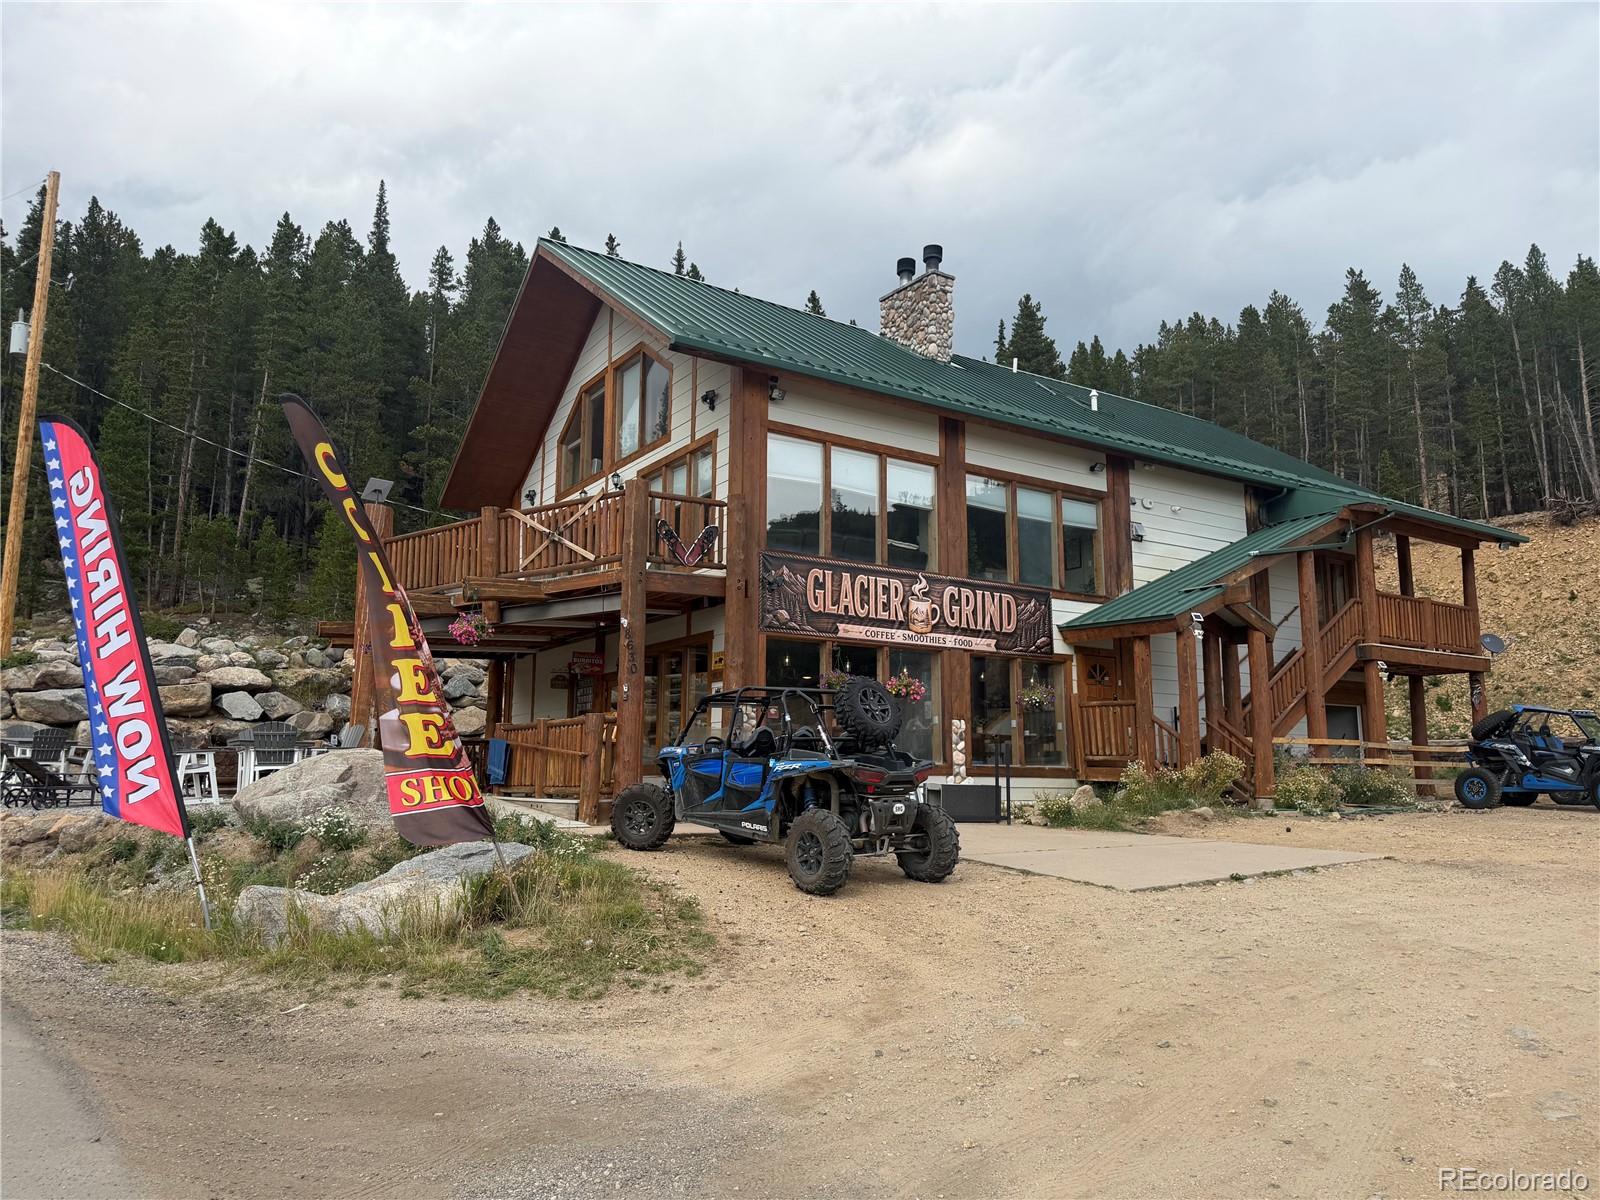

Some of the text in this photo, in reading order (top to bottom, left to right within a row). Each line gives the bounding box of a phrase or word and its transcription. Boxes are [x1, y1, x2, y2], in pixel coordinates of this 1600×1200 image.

[806, 568, 1018, 633] GLACIER GRIND
[864, 628, 974, 648] COFFEE SMOOTHIES FOOD
[741, 821, 768, 832] POLARIS
